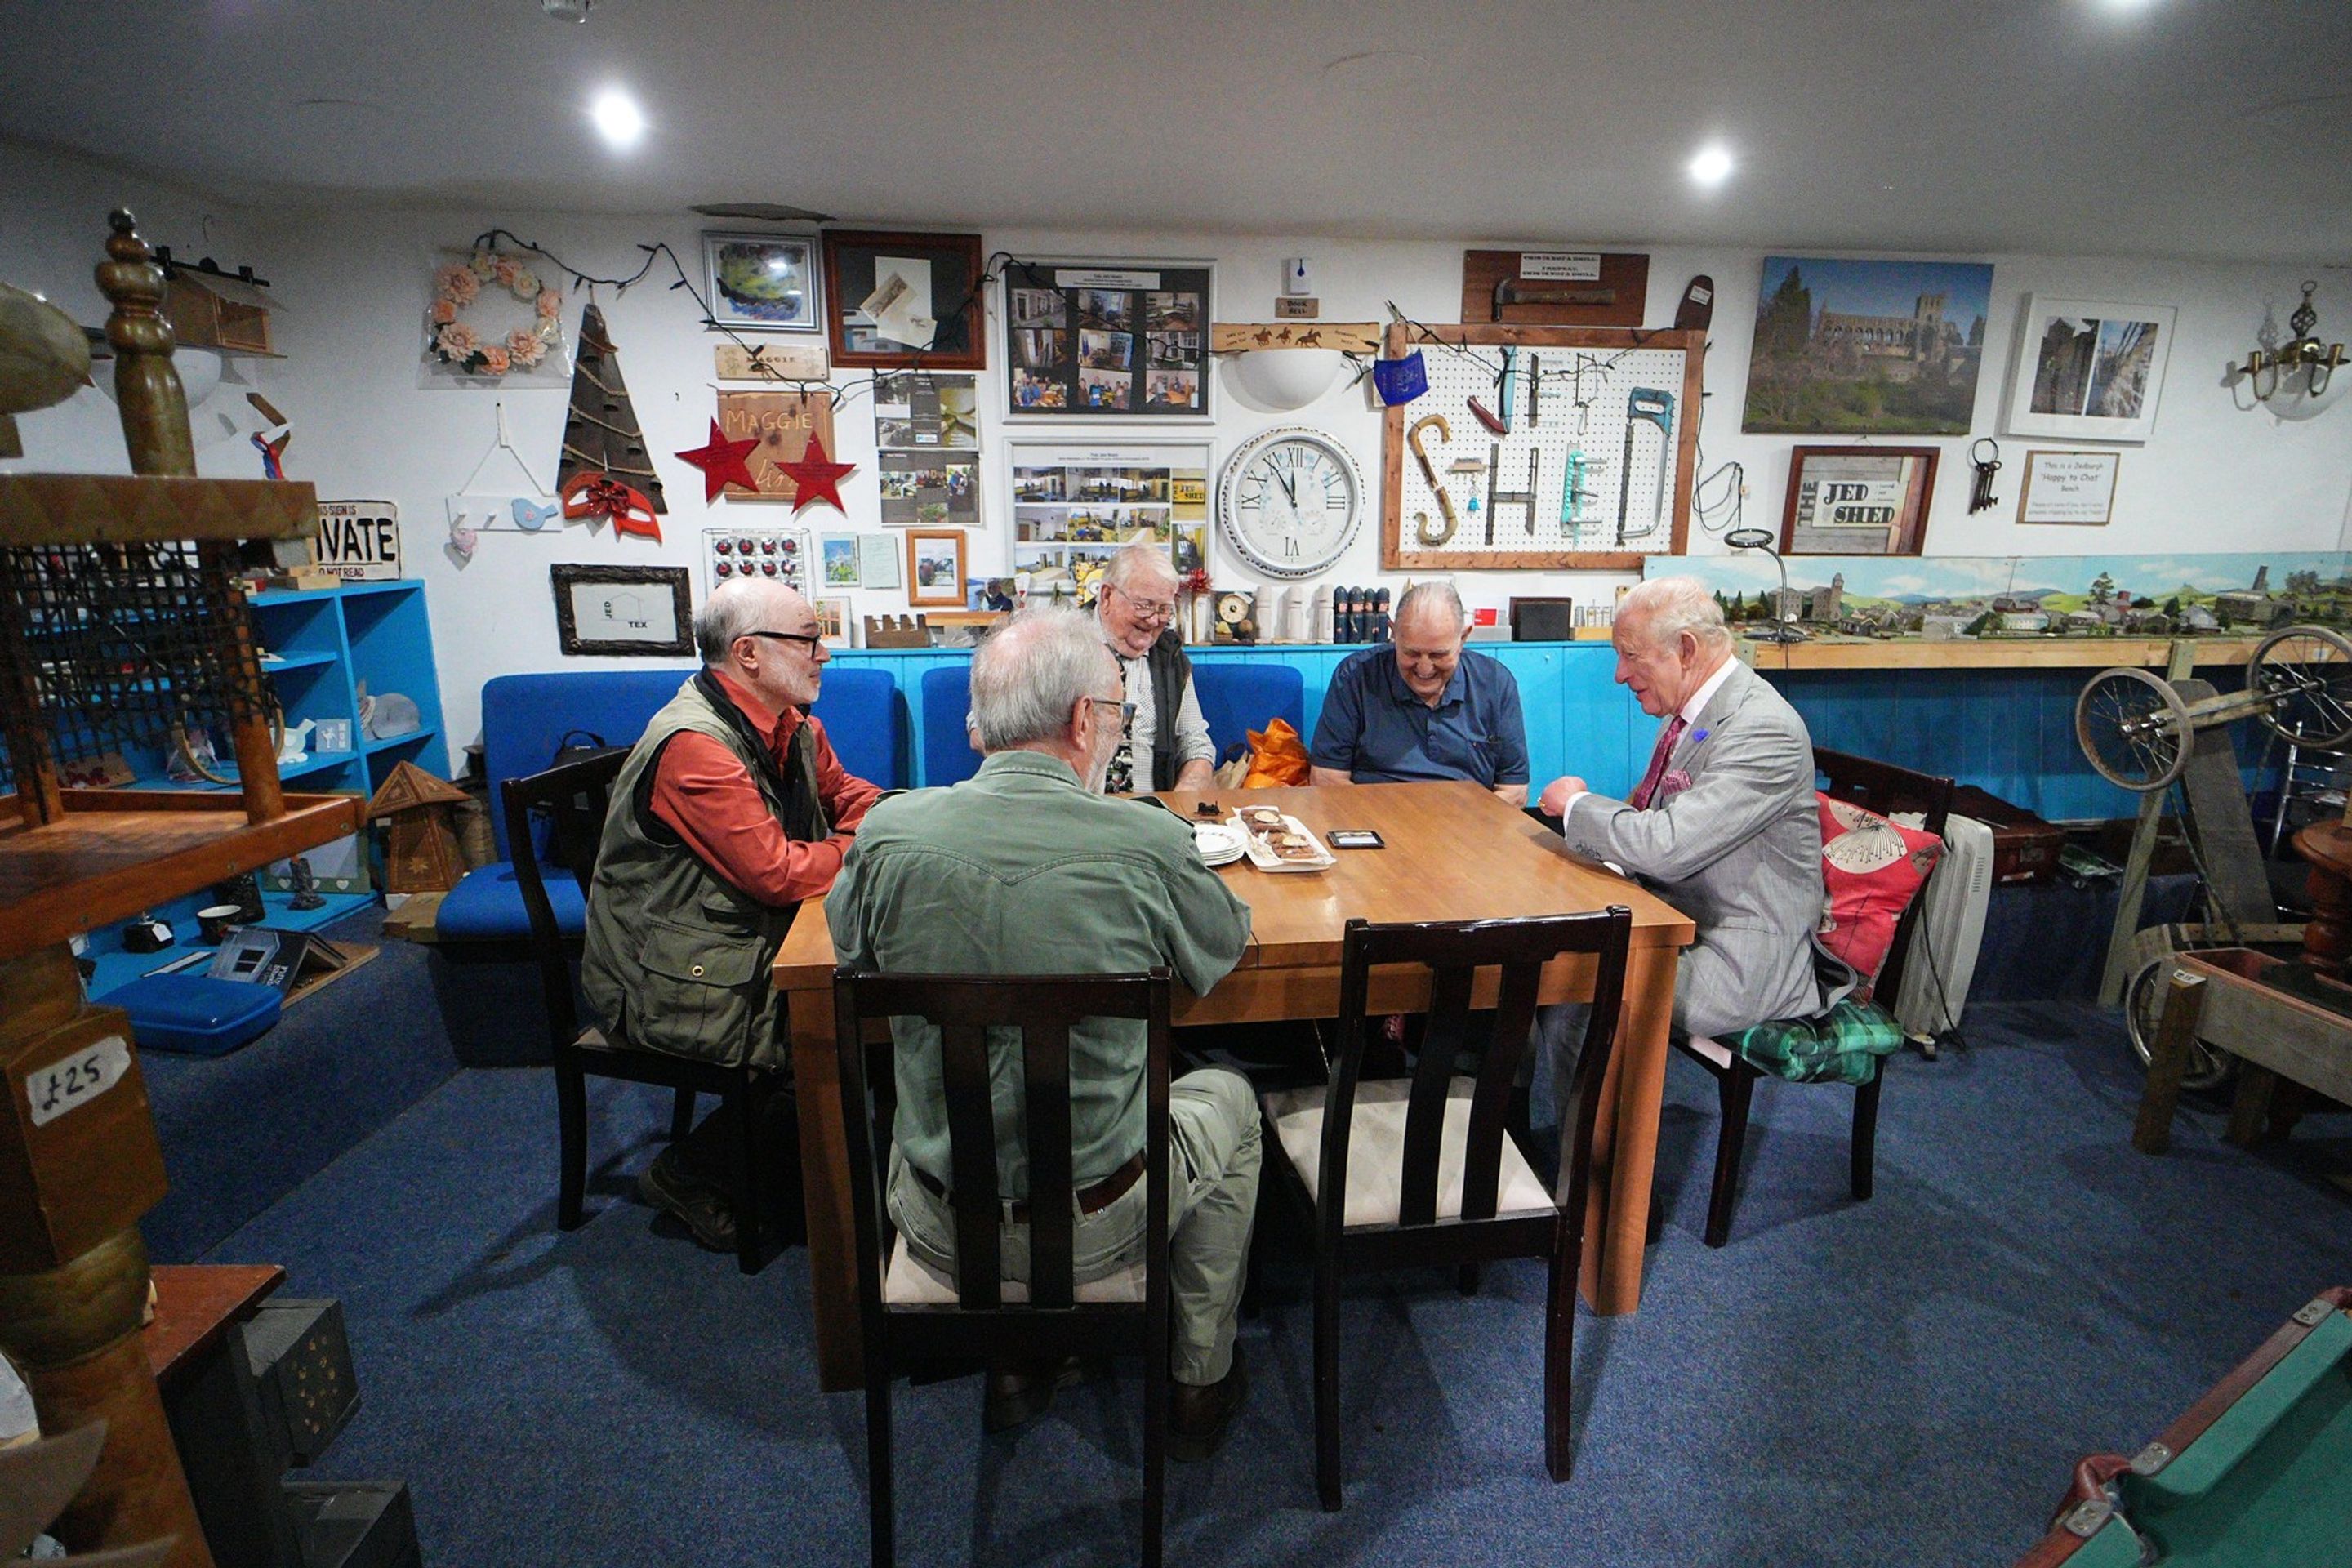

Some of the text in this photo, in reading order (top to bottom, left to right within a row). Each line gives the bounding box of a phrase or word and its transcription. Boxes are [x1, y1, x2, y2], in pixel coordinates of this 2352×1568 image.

[726, 410, 813, 433] MAGGIE
[1797, 481, 1820, 527] THE
[1823, 483, 1869, 505] JED
[328, 506, 348, 515] SIGN
[349, 506, 356, 514] IS
[1833, 506, 1895, 523] SHED
[317, 518, 395, 561] IVATE
[343, 567, 364, 577] READ
[604, 601, 612, 619] JED
[42, 1054, 100, 1111] £25
